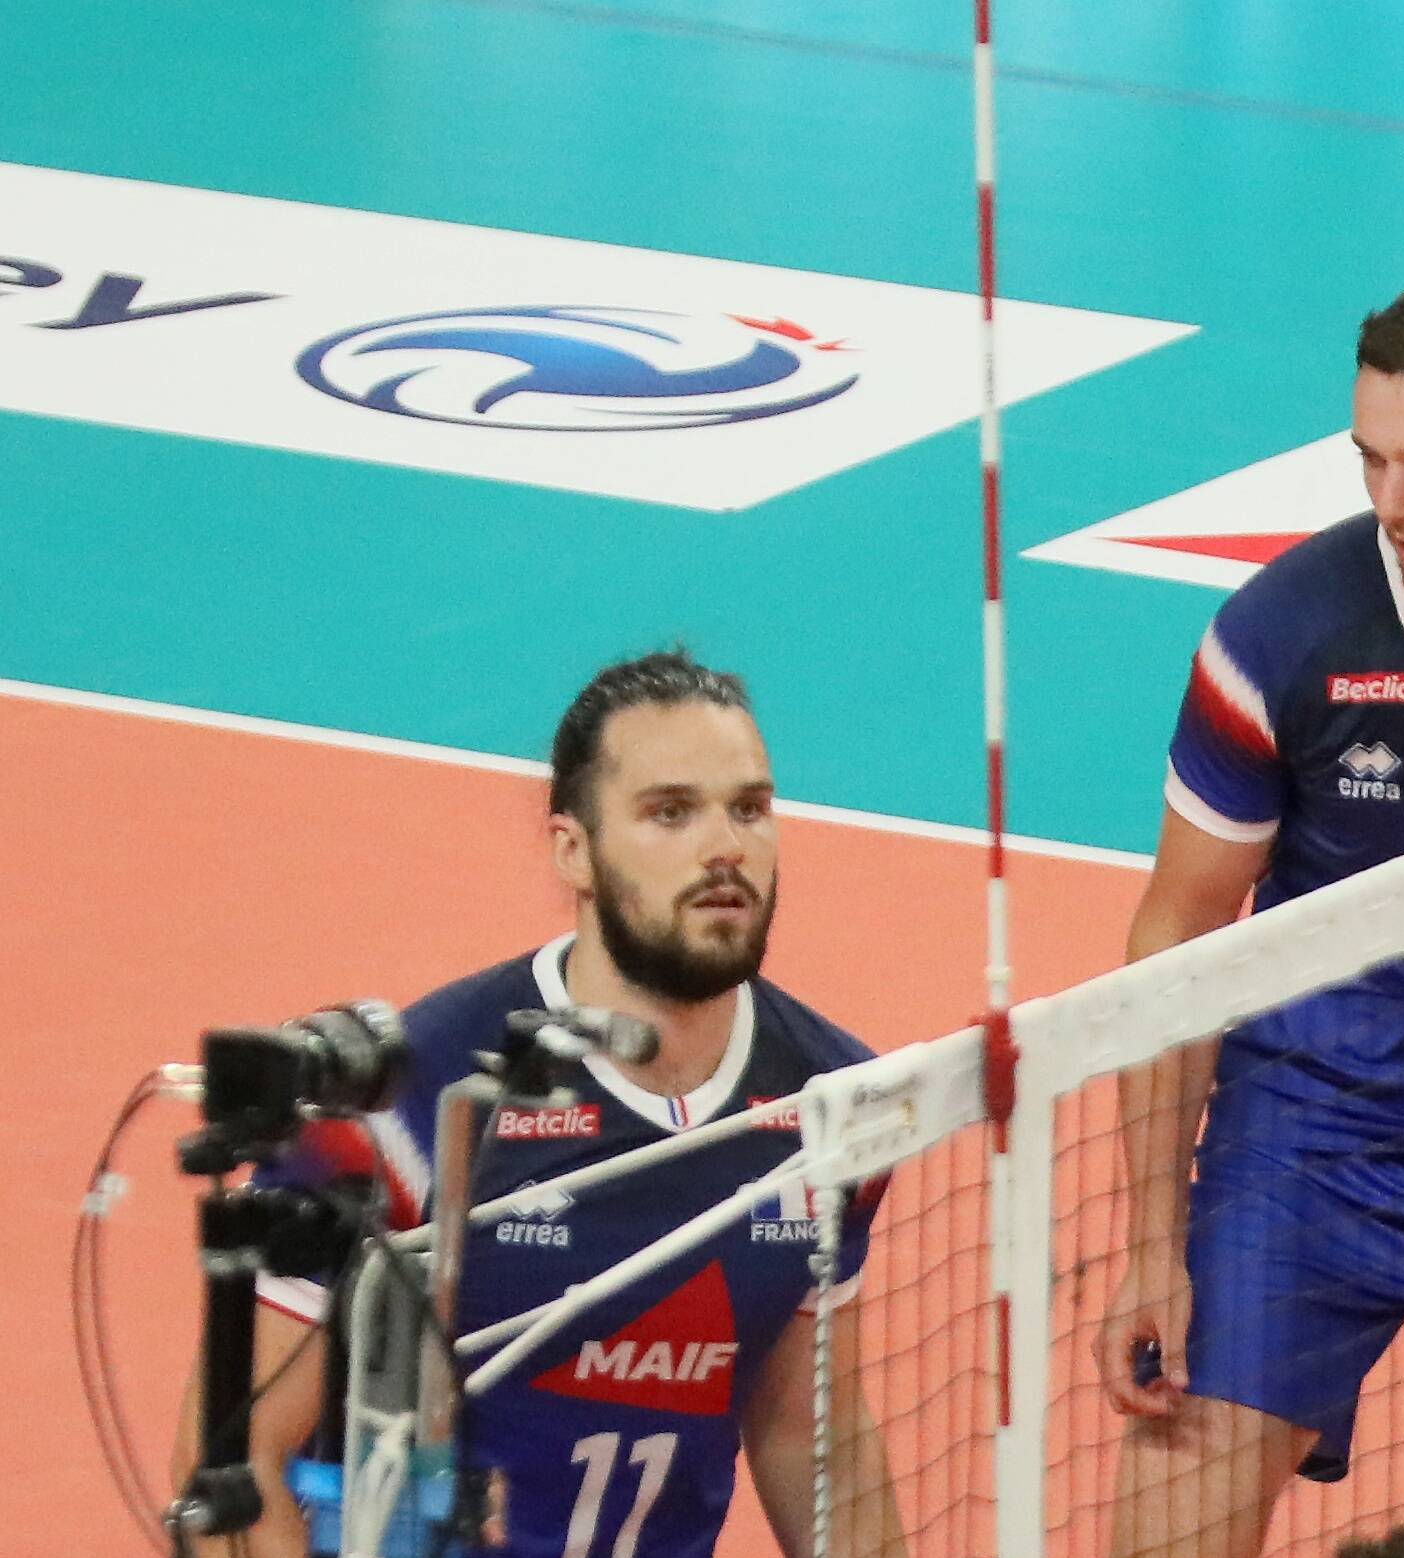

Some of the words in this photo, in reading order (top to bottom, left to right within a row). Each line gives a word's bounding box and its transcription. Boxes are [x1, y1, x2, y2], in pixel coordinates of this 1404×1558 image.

[497, 1107, 597, 1136] Betclic
[495, 1221, 571, 1246] errea
[751, 1222, 819, 1241] FRANC
[574, 1340, 740, 1382] MAIF
